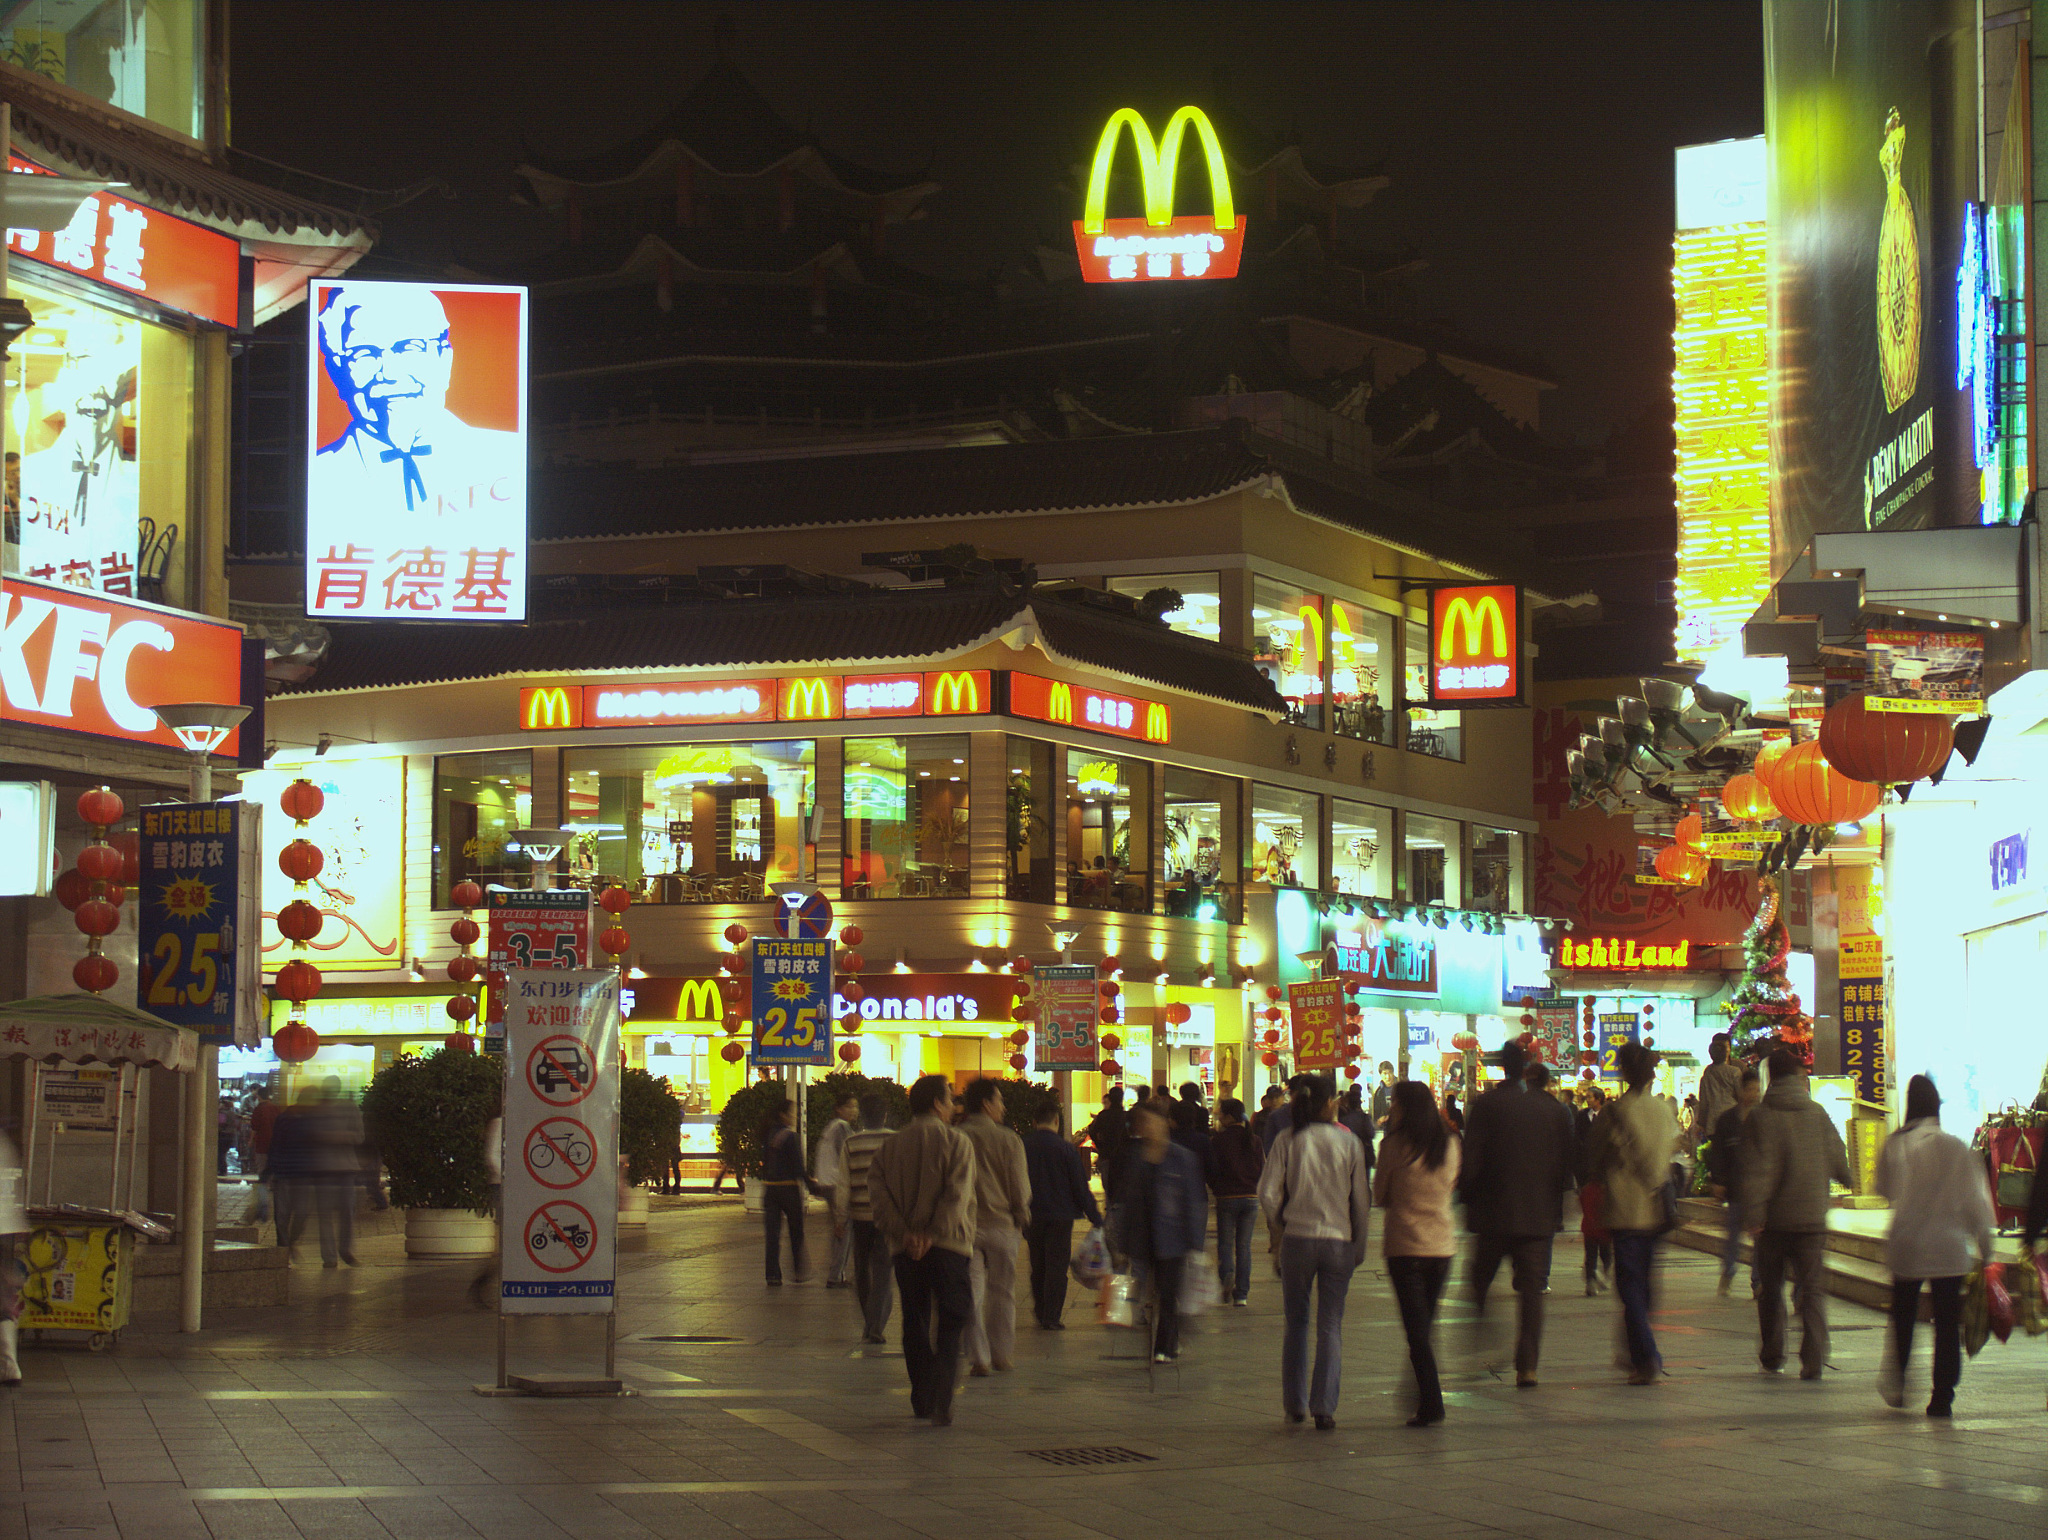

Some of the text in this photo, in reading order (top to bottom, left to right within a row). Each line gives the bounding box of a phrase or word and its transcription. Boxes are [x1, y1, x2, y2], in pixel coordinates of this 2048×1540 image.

[1872, 406, 1934, 498] RÉMY MARTIN
[1875, 506, 1887, 527] FINE
[315, 543, 516, 614] 肯德基
[0, 590, 174, 732] KFC
[145, 808, 232, 837] 东门天虹四楼
[152, 840, 225, 869] 雪豹皮衣
[757, 943, 826, 957] 东门天虹四楼
[146, 932, 220, 1007] 2.5
[764, 958, 820, 975] 雪豹皮衣
[778, 983, 806, 995] 全场
[1296, 995, 1335, 1008] 雪豹皮衣
[526, 1004, 594, 1027] 欢迎您
[760, 1007, 817, 1048] 2.5
[1047, 1021, 1090, 1049] 3-5
[1300, 1029, 1335, 1058] 2.5
[1544, 1020, 1572, 1042] 3-5
[813, 1039, 825, 1052] 折
